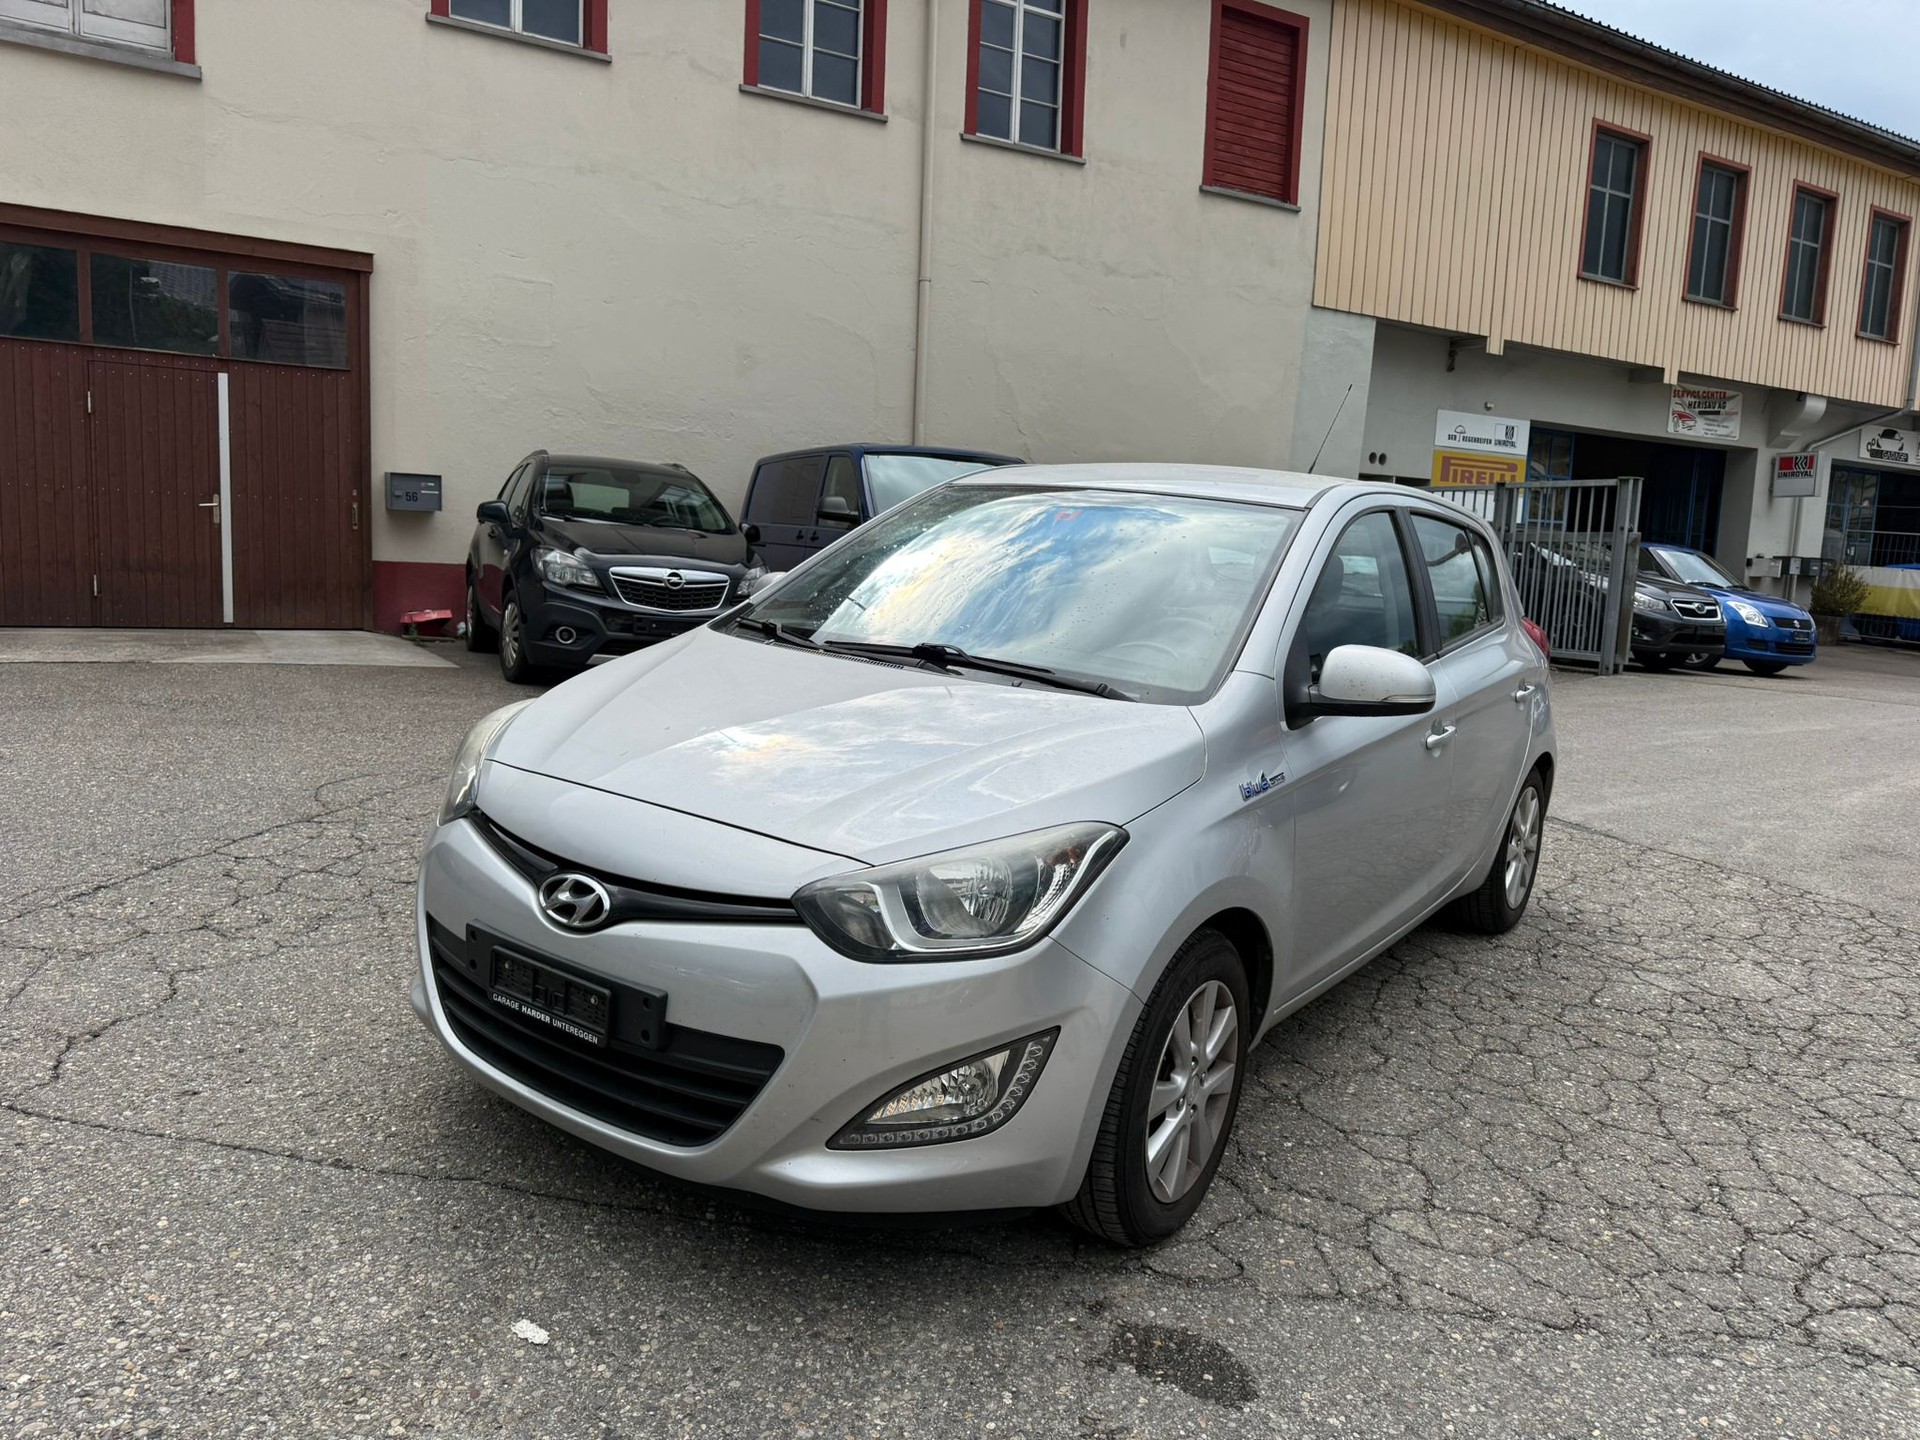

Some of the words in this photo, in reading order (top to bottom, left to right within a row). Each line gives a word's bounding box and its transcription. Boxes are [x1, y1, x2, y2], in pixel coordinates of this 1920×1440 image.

[1673, 389, 1701, 399] SERVICE
[1702, 390, 1727, 400] CENTER
[1688, 400, 1716, 410] HERISAU
[1447, 433, 1457, 441] DER
[1462, 435, 1493, 445] REGENREIFEN
[1494, 438, 1517, 448] UNIROYAL
[405, 491, 418, 502] 56
[492, 993, 520, 1011] GARAGE
[521, 1005, 551, 1024] HARDER
[552, 1018, 598, 1045] UNTEREGGEN
